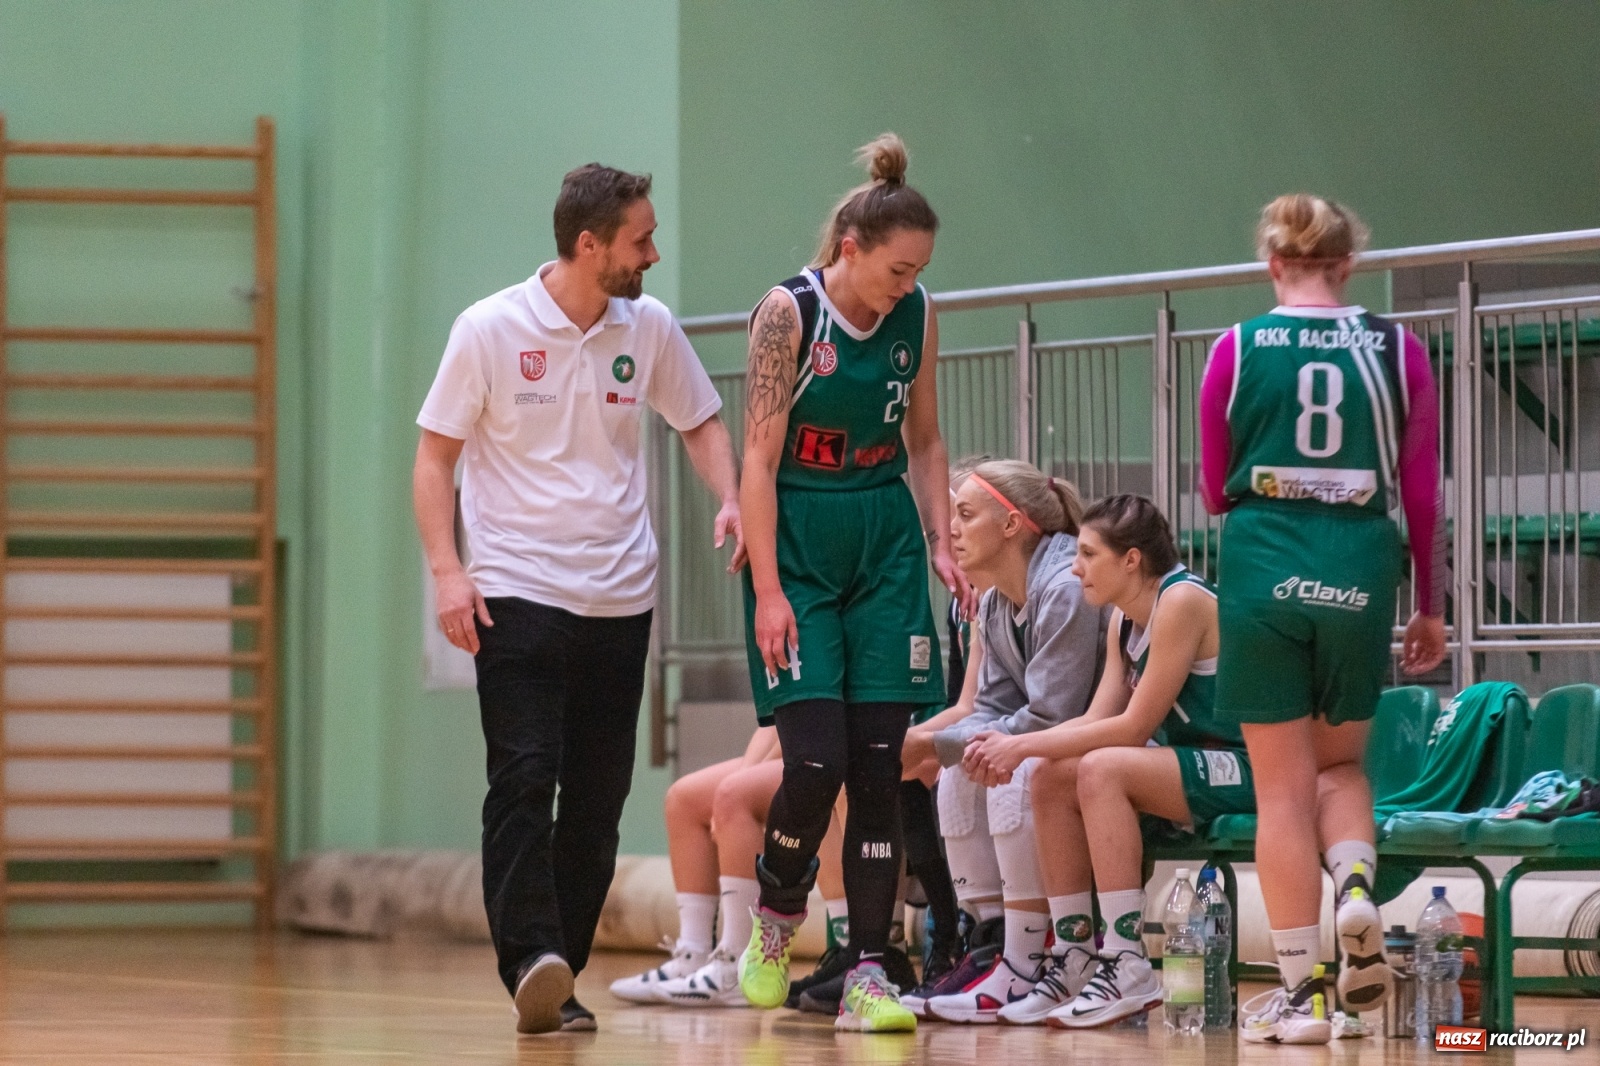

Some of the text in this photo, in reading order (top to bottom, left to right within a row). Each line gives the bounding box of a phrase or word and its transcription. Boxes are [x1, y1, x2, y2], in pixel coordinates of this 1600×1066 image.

[1254, 323, 1387, 351] RKK RACIBÓRZ
[1295, 361, 1344, 458] 8
[799, 430, 839, 467] K
[1297, 580, 1370, 607] Clavis
[778, 834, 801, 849] NBA
[871, 842, 892, 859] NBA
